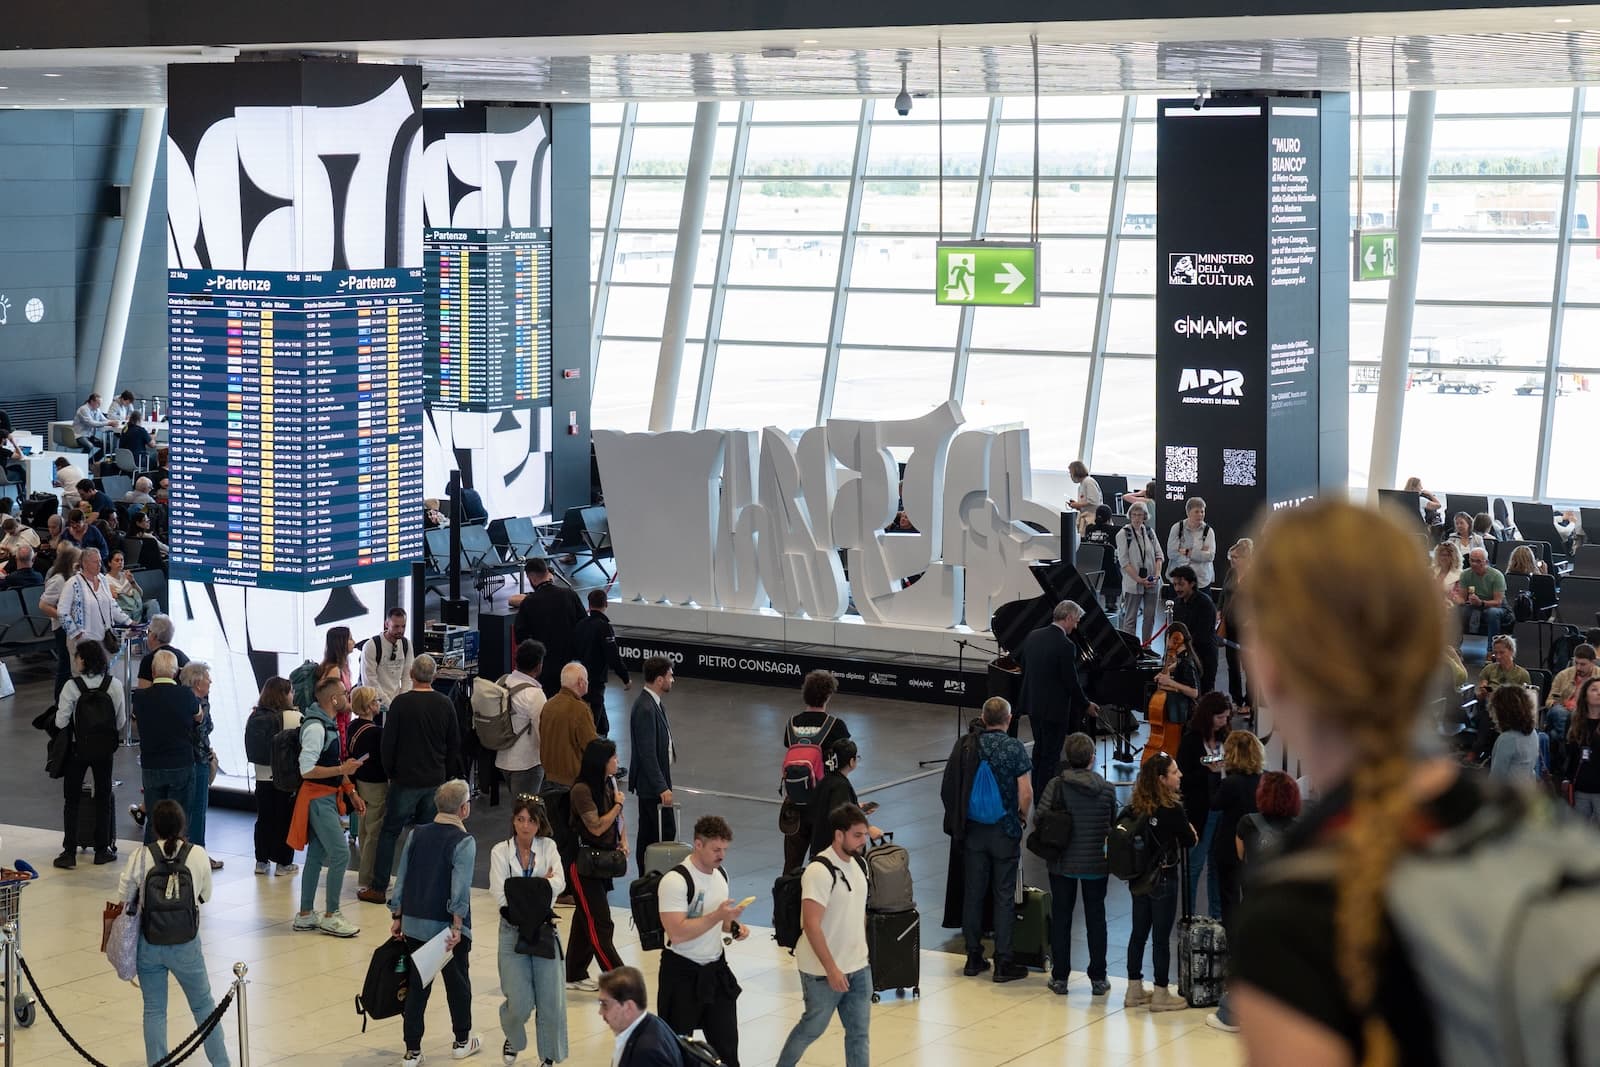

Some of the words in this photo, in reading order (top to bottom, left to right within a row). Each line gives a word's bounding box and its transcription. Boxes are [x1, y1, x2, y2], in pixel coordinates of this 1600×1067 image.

[434, 231, 468, 240] Partenze
[510, 231, 537, 240] Partenze
[1198, 253, 1254, 265] MINISTERO
[1198, 264, 1224, 274] DELLA
[216, 275, 271, 291] Partenze
[348, 276, 396, 290] Partenze
[1198, 274, 1254, 287] CULTURA
[1178, 368, 1244, 397] ADR
[1166, 484, 1186, 494] Scopri
[1166, 492, 1172, 500] di
[1173, 492, 1184, 501] più
[618, 646, 641, 659] URO
[698, 654, 737, 669] PIETRO
[739, 658, 802, 675] CONSAGRA
[846, 672, 865, 680] dipinto
